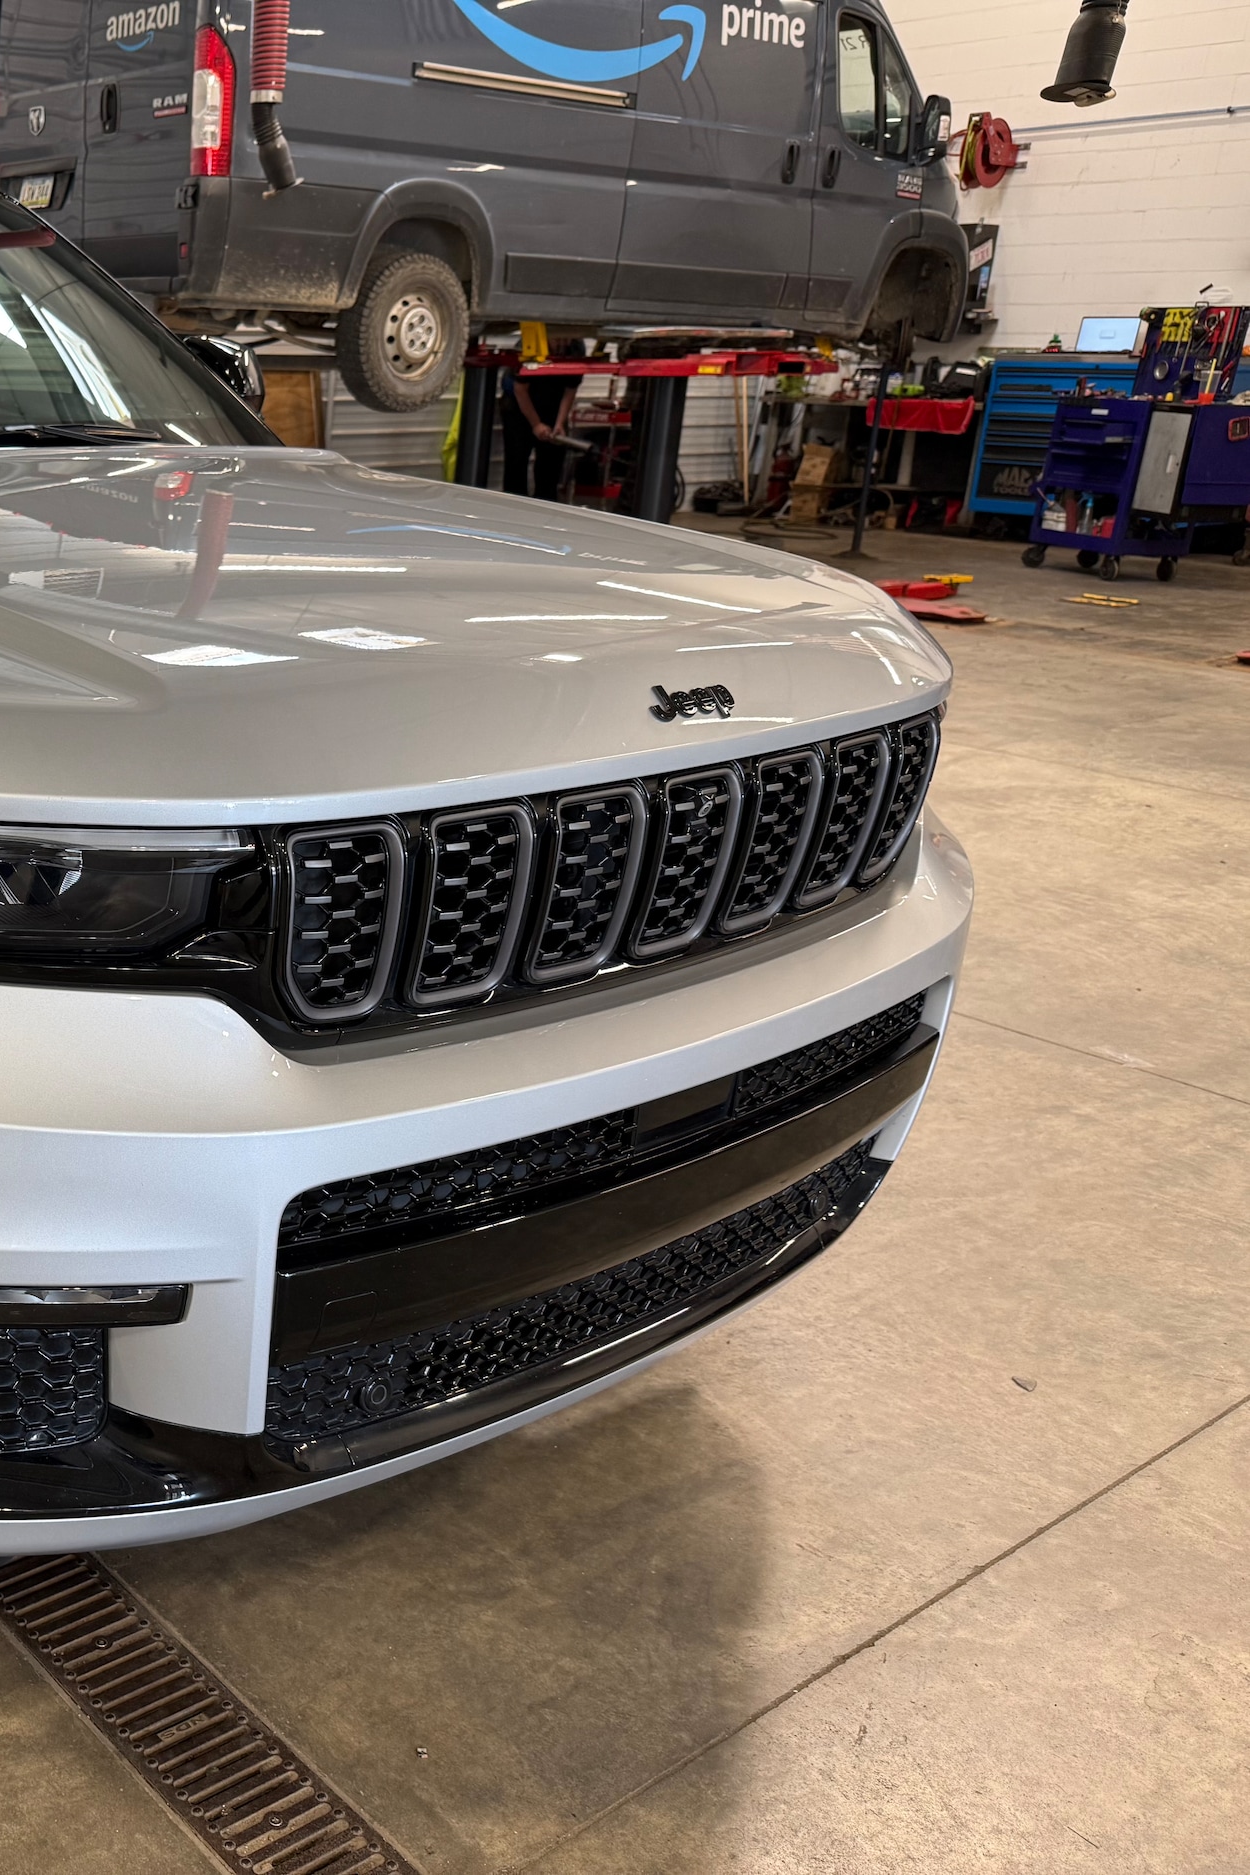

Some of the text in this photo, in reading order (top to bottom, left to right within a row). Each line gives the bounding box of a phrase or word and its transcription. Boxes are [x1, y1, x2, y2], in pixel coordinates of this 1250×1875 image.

[106, 0, 180, 41] amazon
[721, 0, 806, 48] prime
[152, 93, 188, 108] RAM
[649, 684, 735, 722] Jeep
